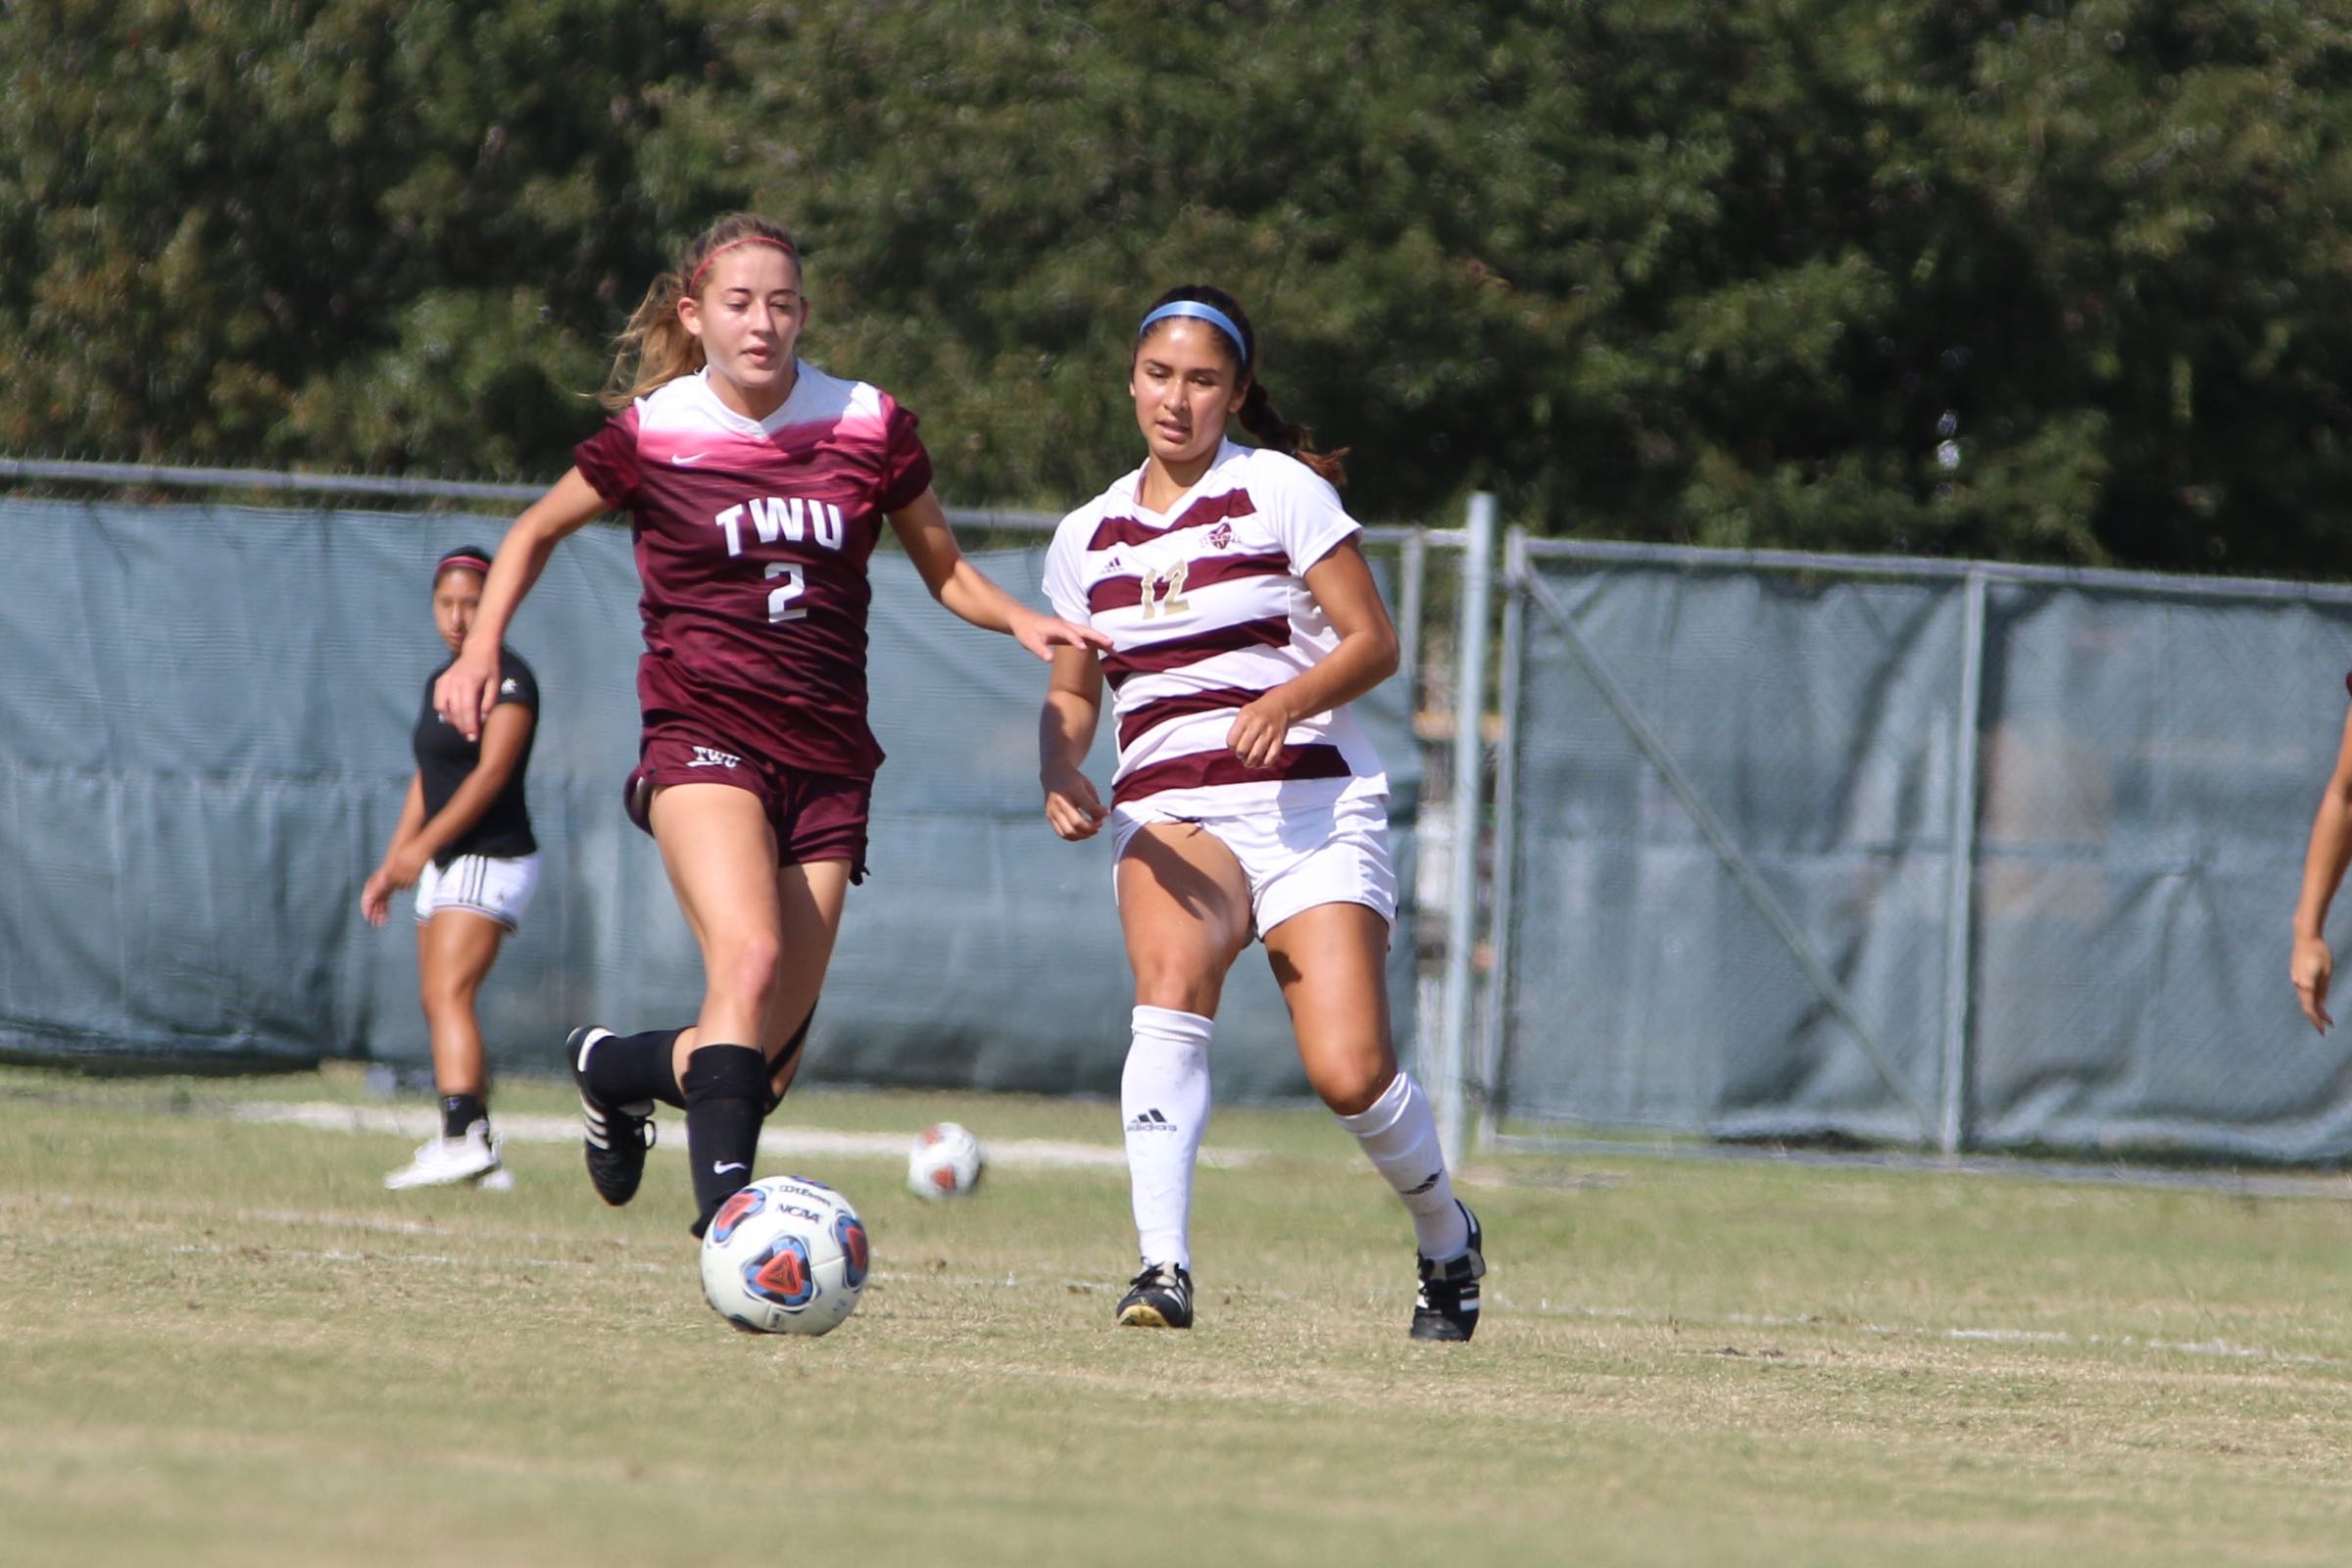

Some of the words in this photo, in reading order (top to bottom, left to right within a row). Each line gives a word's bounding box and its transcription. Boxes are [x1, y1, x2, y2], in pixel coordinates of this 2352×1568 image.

[714, 496, 843, 558] TWU
[763, 562, 808, 624] 2
[1141, 559, 1190, 620] 12
[690, 745, 743, 768] TWU
[775, 1202, 820, 1224] NCAA
